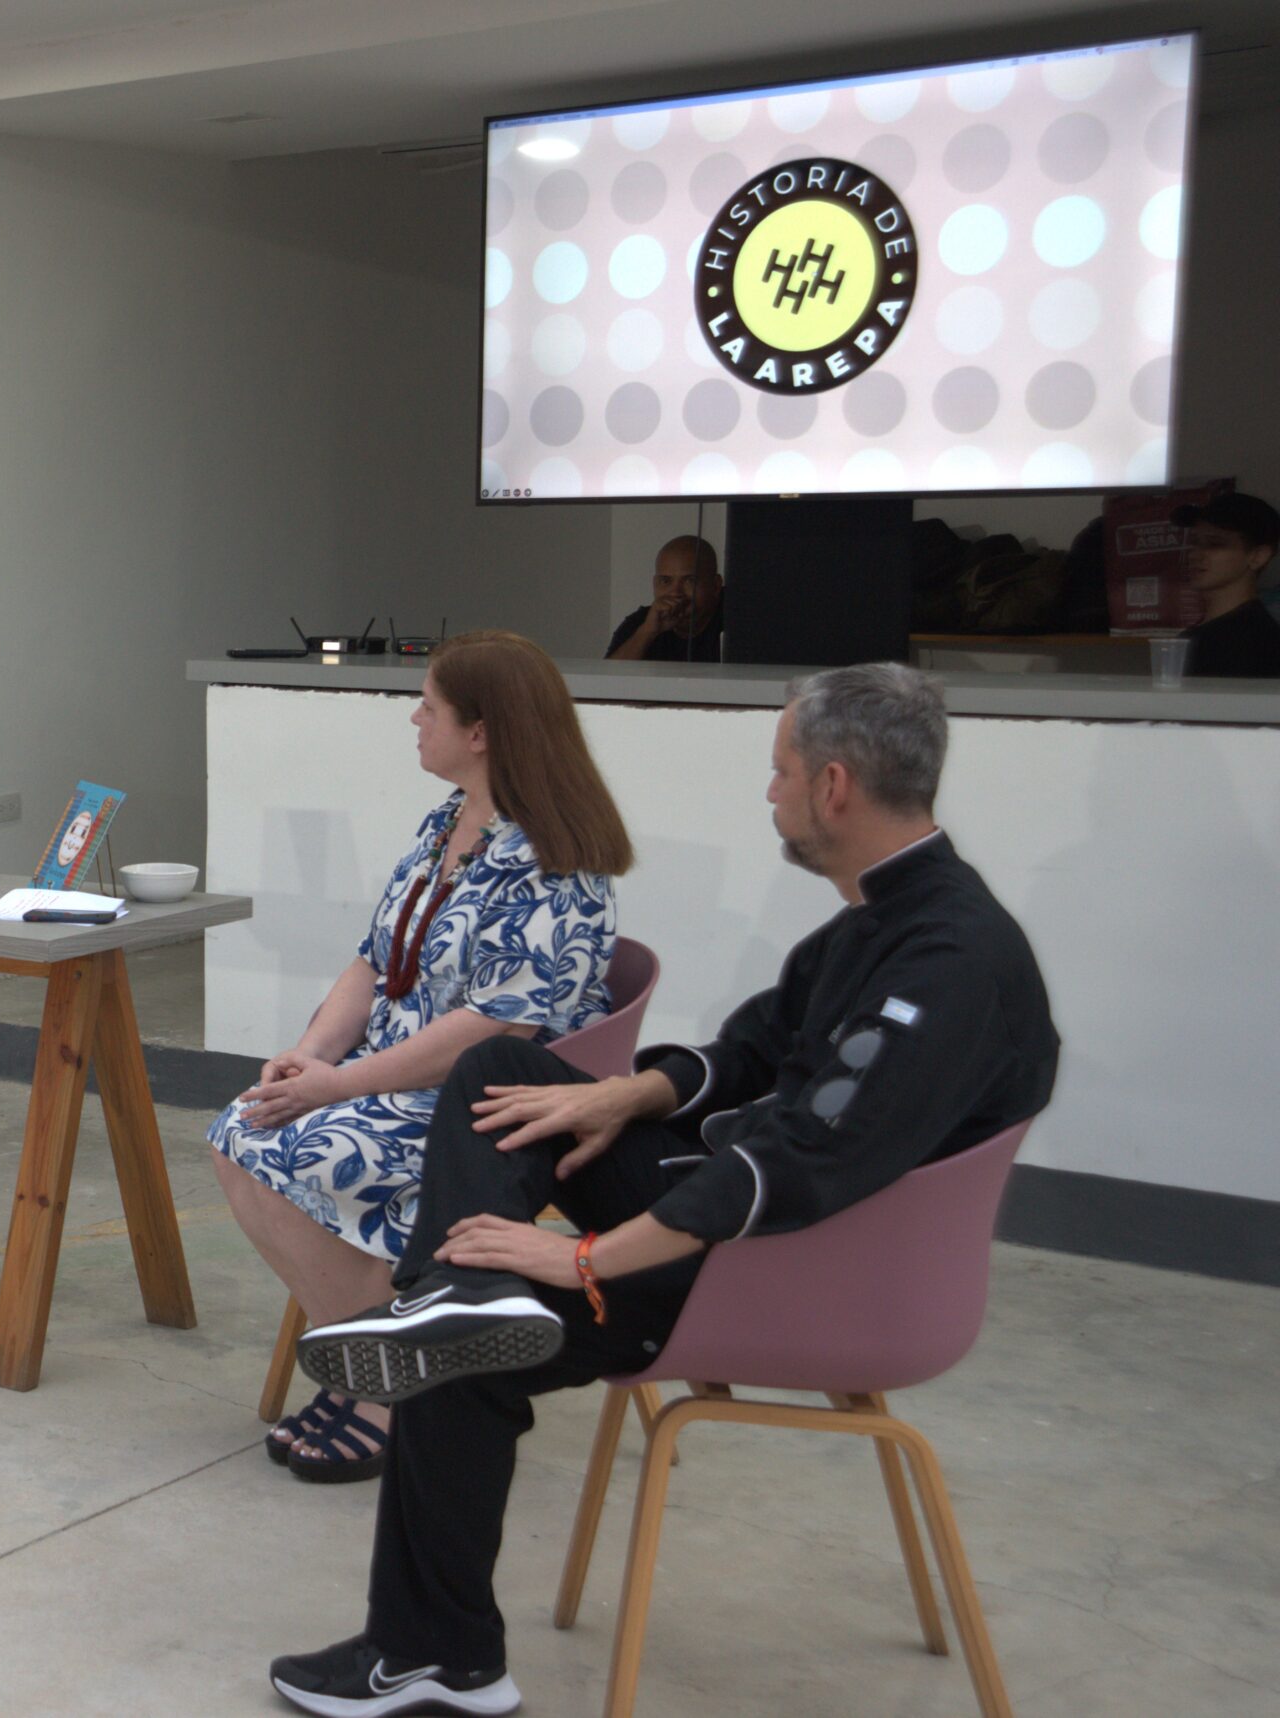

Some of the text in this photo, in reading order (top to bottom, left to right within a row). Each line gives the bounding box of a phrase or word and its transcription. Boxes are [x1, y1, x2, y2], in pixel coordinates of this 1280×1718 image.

[704, 166, 909, 271] HISTORIA DE
[708, 300, 905, 388] LA AREPA
[1136, 533, 1179, 550] ASIA
